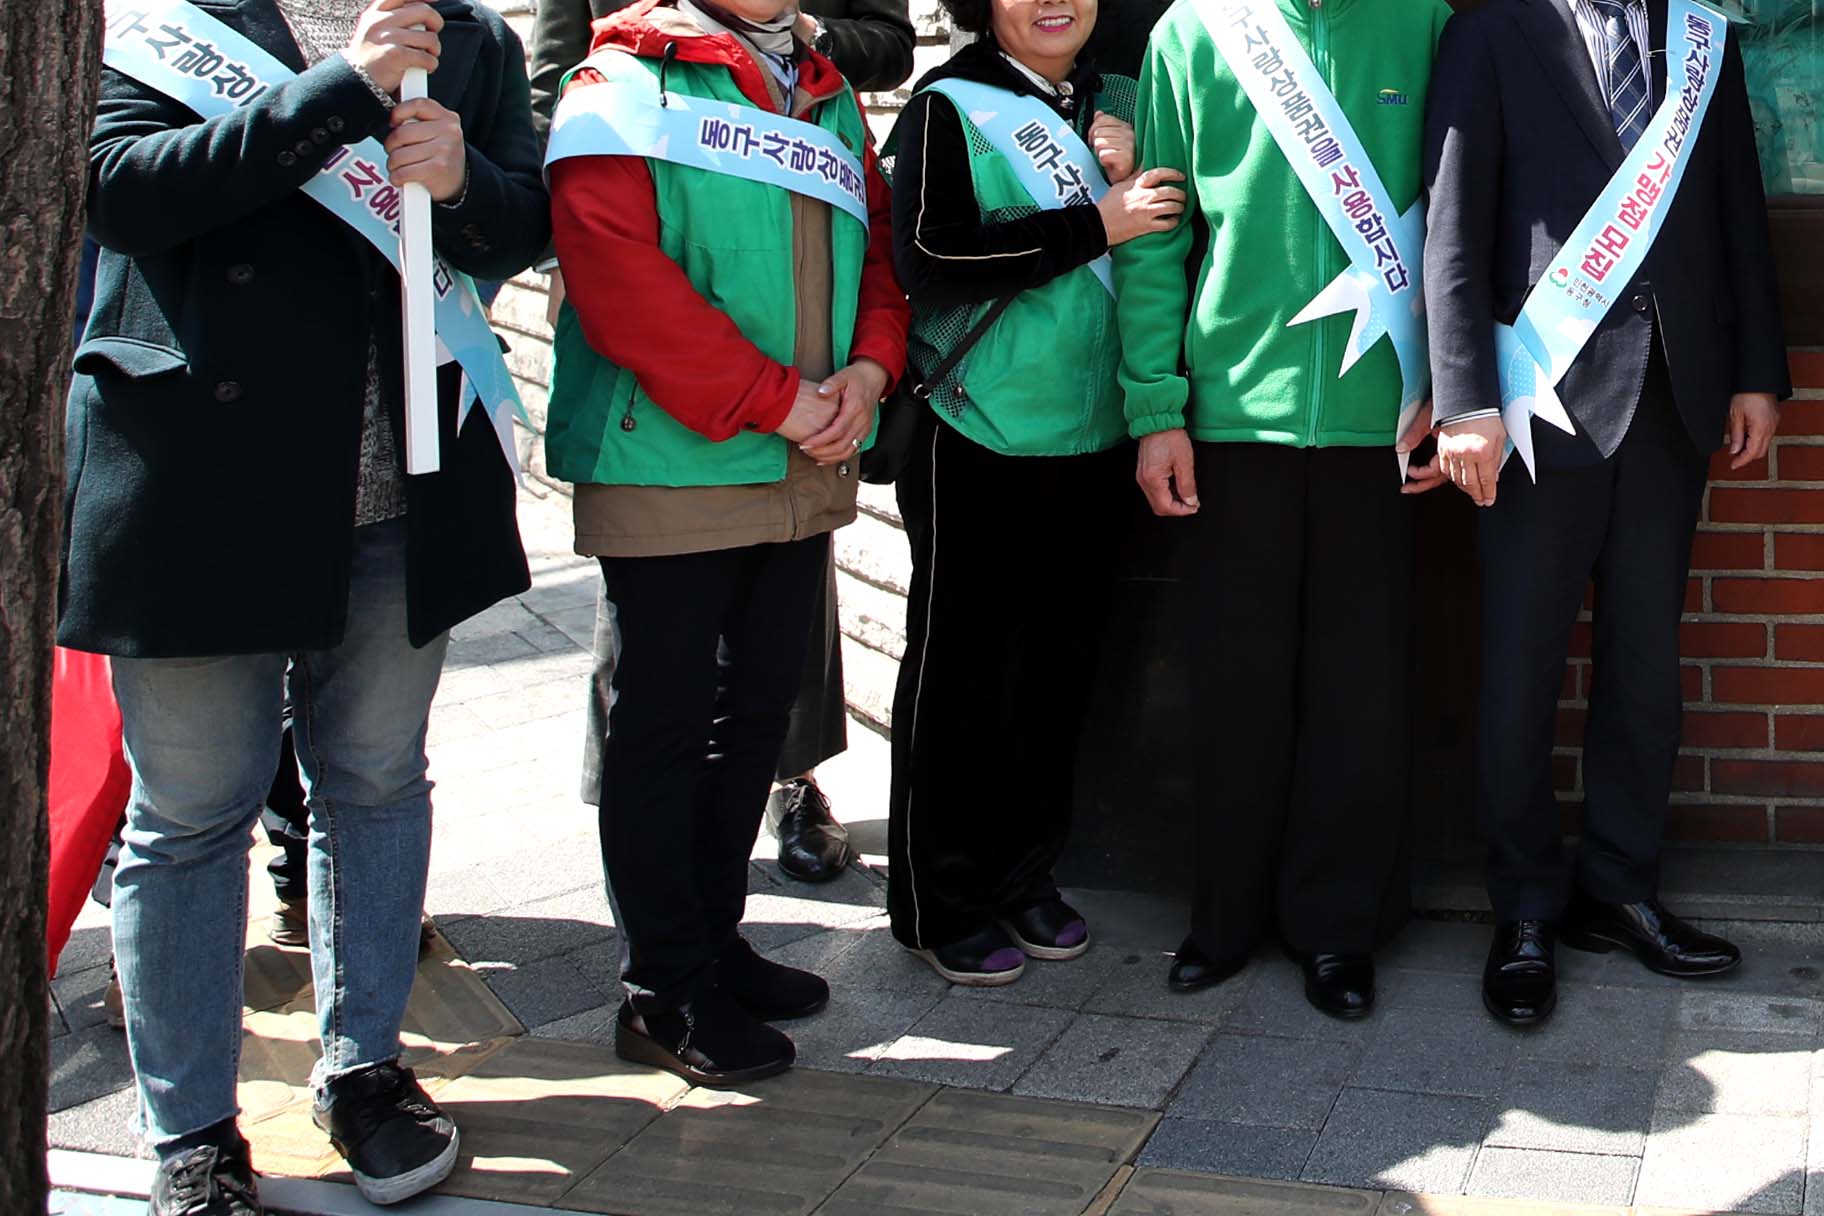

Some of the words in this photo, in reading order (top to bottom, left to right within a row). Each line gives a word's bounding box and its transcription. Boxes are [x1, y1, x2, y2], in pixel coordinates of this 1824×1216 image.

[1375, 93, 1409, 105] SMU
[1664, 12, 1715, 158] 동구사랑상품권
[1618, 151, 1674, 231] 가맹점
[1330, 164, 1410, 293] 사용합시다
[1577, 224, 1630, 283] 모집
[1572, 277, 1610, 308] 인천광역시
